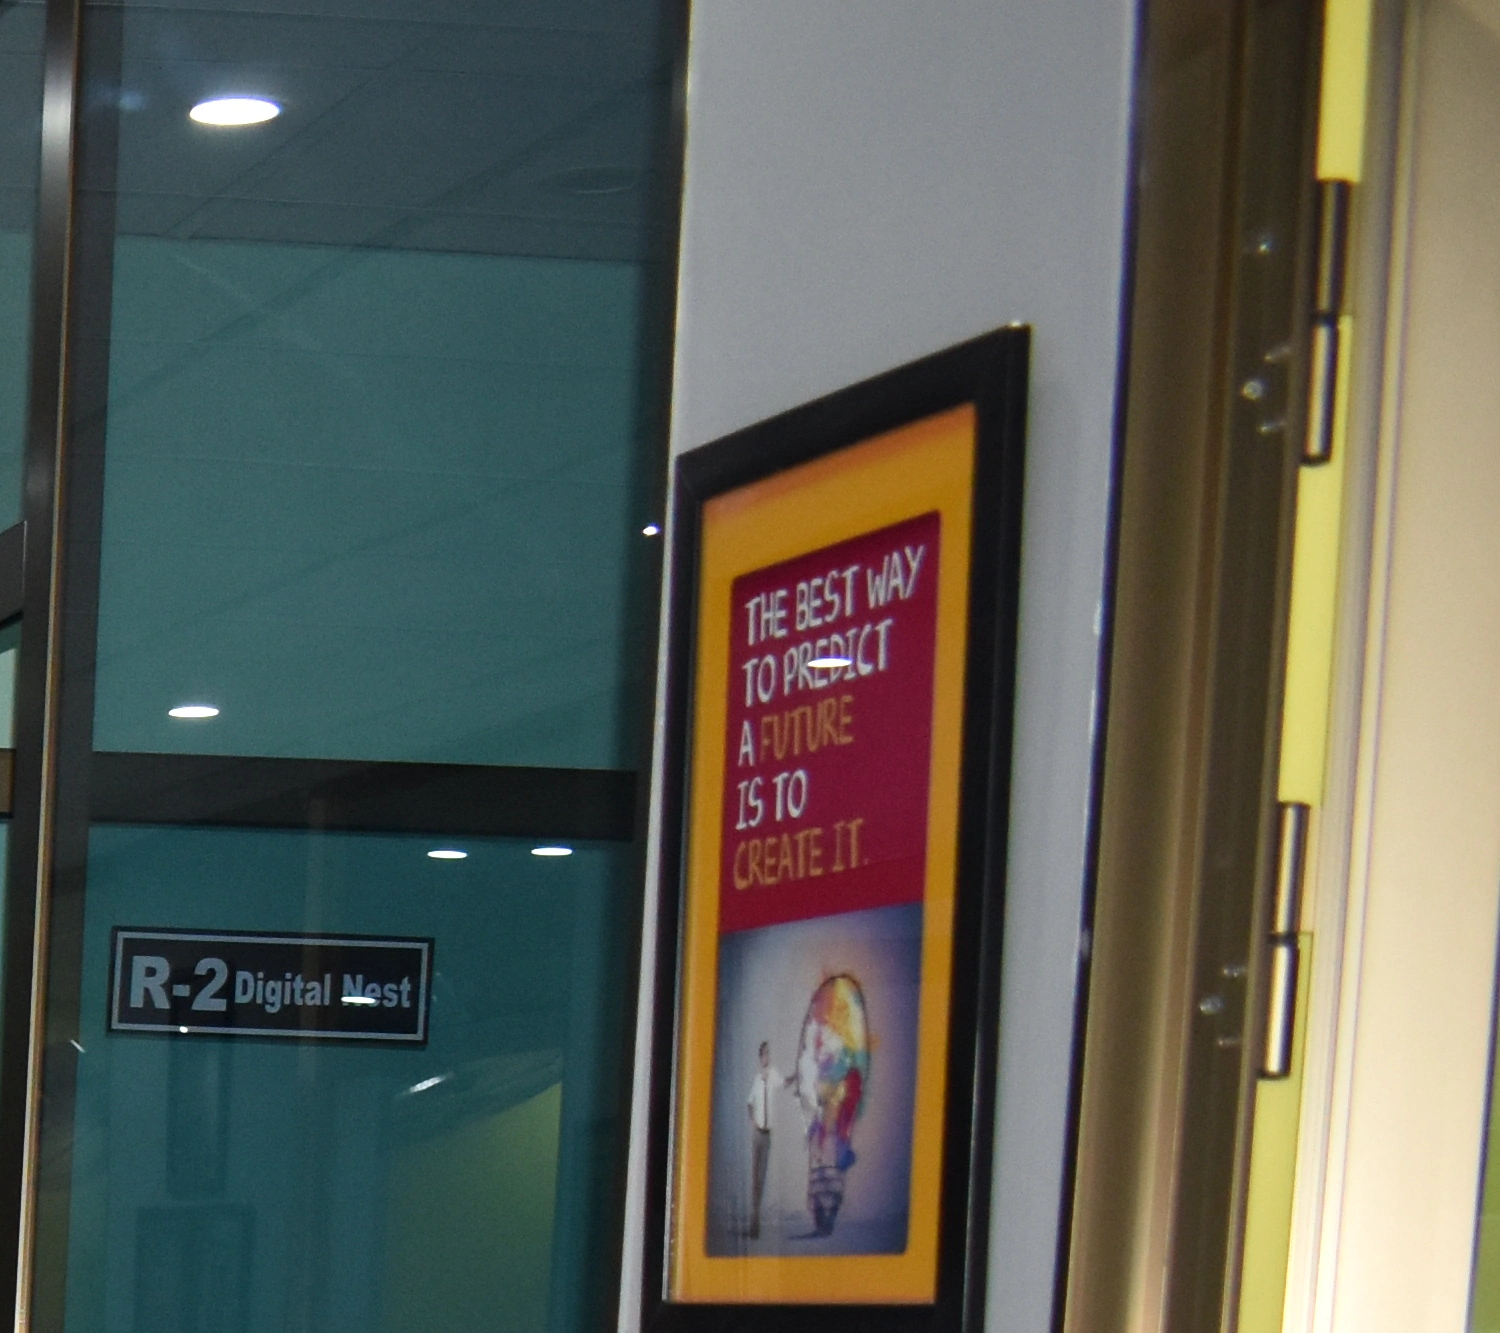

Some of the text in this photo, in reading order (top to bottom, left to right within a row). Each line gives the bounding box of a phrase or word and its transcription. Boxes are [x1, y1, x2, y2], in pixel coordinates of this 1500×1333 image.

[746, 546, 923, 645] THE BEST WAY
[743, 619, 892, 706] TO PREDICT
[738, 695, 853, 766] A FUTURE
[736, 769, 807, 830] IS TO
[734, 828, 823, 890] CREATE
[130, 956, 411, 1013] R-2 Digital Nest
